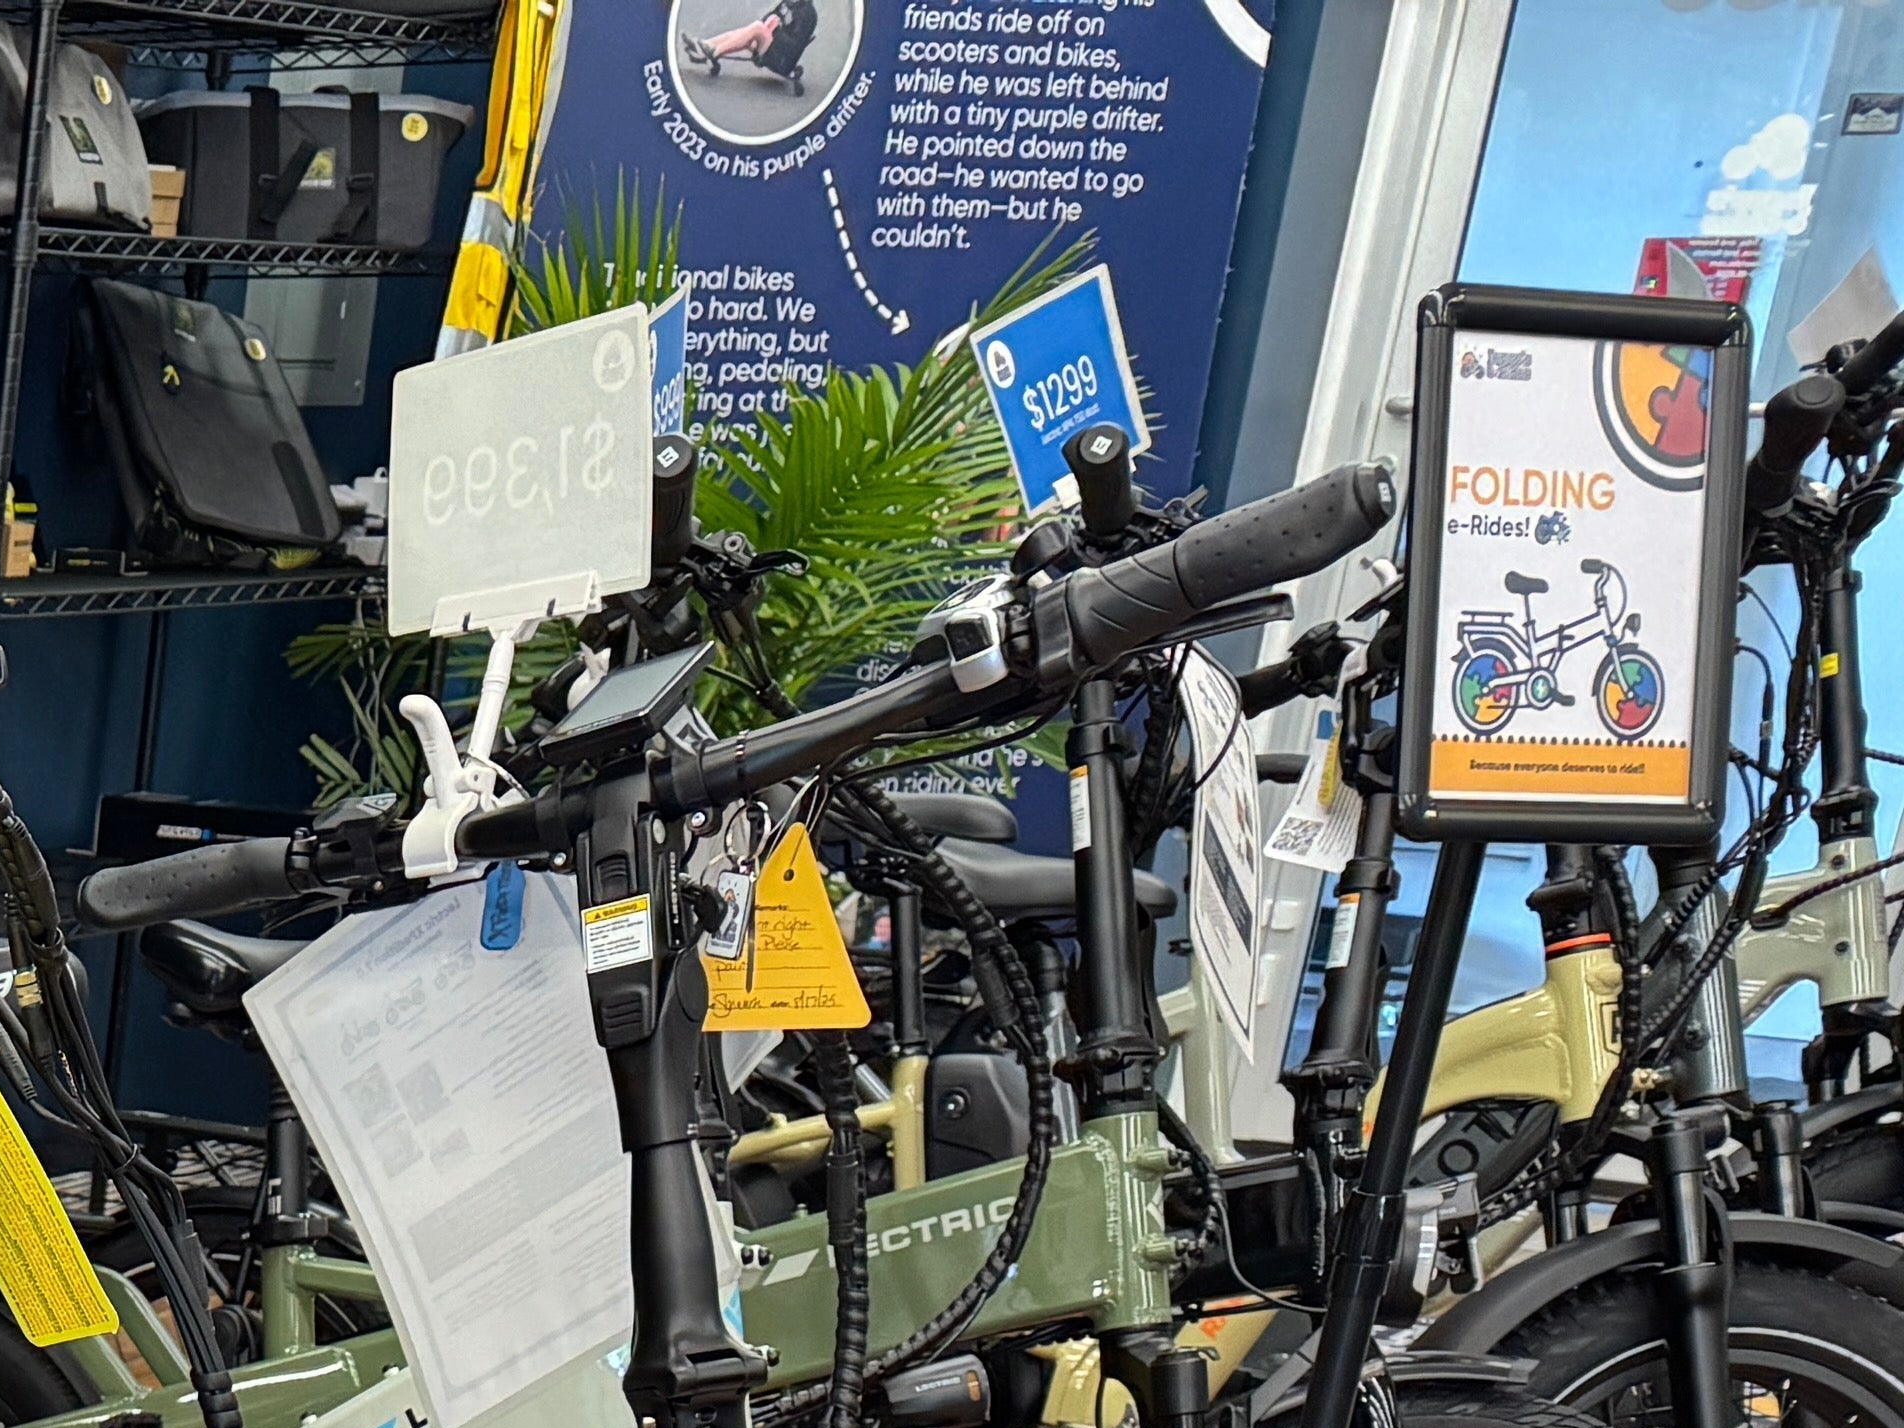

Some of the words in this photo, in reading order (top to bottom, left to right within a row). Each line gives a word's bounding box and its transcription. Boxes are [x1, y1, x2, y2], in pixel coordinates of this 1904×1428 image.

[903, 3, 982, 31] friends
[987, 7, 1032, 34] ride
[1037, 7, 1072, 36] off
[1074, 15, 1105, 36] on
[898, 40, 999, 65] scooters
[1004, 41, 1052, 66] and
[1056, 43, 1121, 72] bikes,
[894, 67, 955, 95] while
[958, 70, 989, 96] he
[994, 74, 1042, 98] was
[1046, 71, 1085, 98] left
[1089, 74, 1169, 102] behind
[644, 59, 671, 117] Early
[663, 113, 708, 161] 2023
[704, 152, 729, 175] on
[732, 154, 760, 177] his
[763, 133, 826, 181] purple
[826, 70, 877, 138] drifter.
[890, 98, 939, 124] with
[944, 105, 961, 125] a
[967, 101, 1008, 132] tiny
[1012, 102, 1088, 134] purple
[1092, 104, 1164, 132] drifter.
[884, 129, 918, 155] He
[921, 131, 1015, 161] pointed
[1019, 134, 1084, 160] down
[1089, 137, 1127, 162] the
[990, 166, 1080, 191] wanted
[1084, 168, 1108, 192] to
[1112, 172, 1144, 198] go
[876, 192, 925, 218] with
[1052, 196, 1083, 221] he
[733, 265, 795, 292] bikes
[708, 295, 768, 322] hard.
[776, 297, 817, 323] We
[684, 327, 782, 358] erything,
[788, 328, 830, 353] but
[718, 358, 829, 389] pedaling,
[739, 391, 766, 412] at
[1023, 355, 1099, 432] $1299
[1450, 465, 1616, 511] FOLDING
[1447, 514, 1530, 538] e-Rides!
[1470, 760, 1512, 771] Because
[1514, 762, 1559, 774] everyone
[1562, 763, 1605, 774] deserves
[1607, 765, 1618, 774] to
